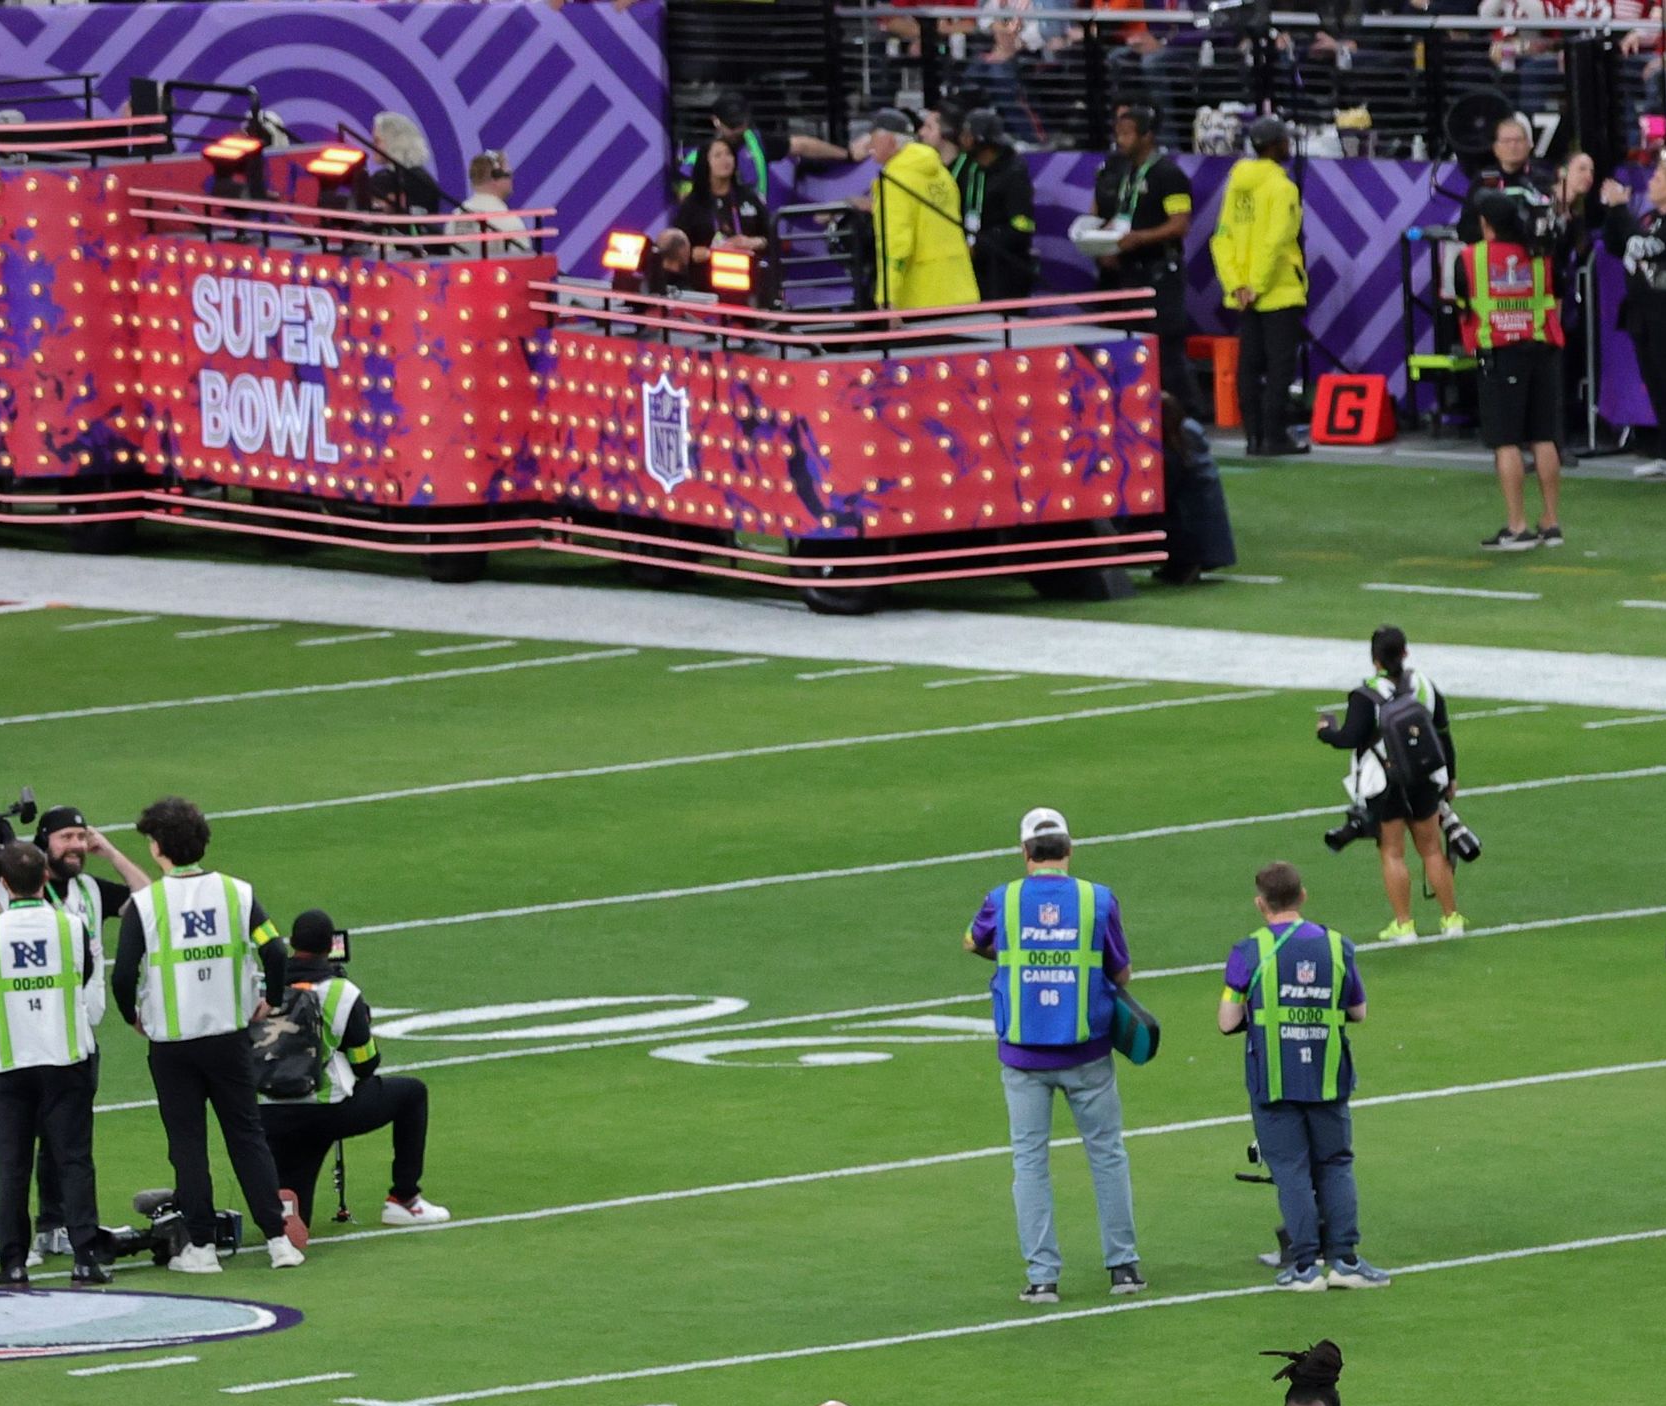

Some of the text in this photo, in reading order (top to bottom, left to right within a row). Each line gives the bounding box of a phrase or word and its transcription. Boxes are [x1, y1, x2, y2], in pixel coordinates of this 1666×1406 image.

[199, 368, 340, 464] BOWL
[1325, 385, 1367, 436] G
[181, 908, 217, 939] N
[1021, 927, 1078, 941] FILMS
[10, 939, 48, 969] N
[183, 945, 224, 962] 00:00
[1028, 951, 1071, 965] 00:00
[198, 968, 212, 982] 07
[1022, 970, 1076, 983] CAMERA
[13, 975, 55, 991] 00:00
[1039, 989, 1059, 1006] 06
[1280, 984, 1332, 999] FILMS
[28, 998, 43, 1011] 14
[1288, 1008, 1323, 1023] 00:00
